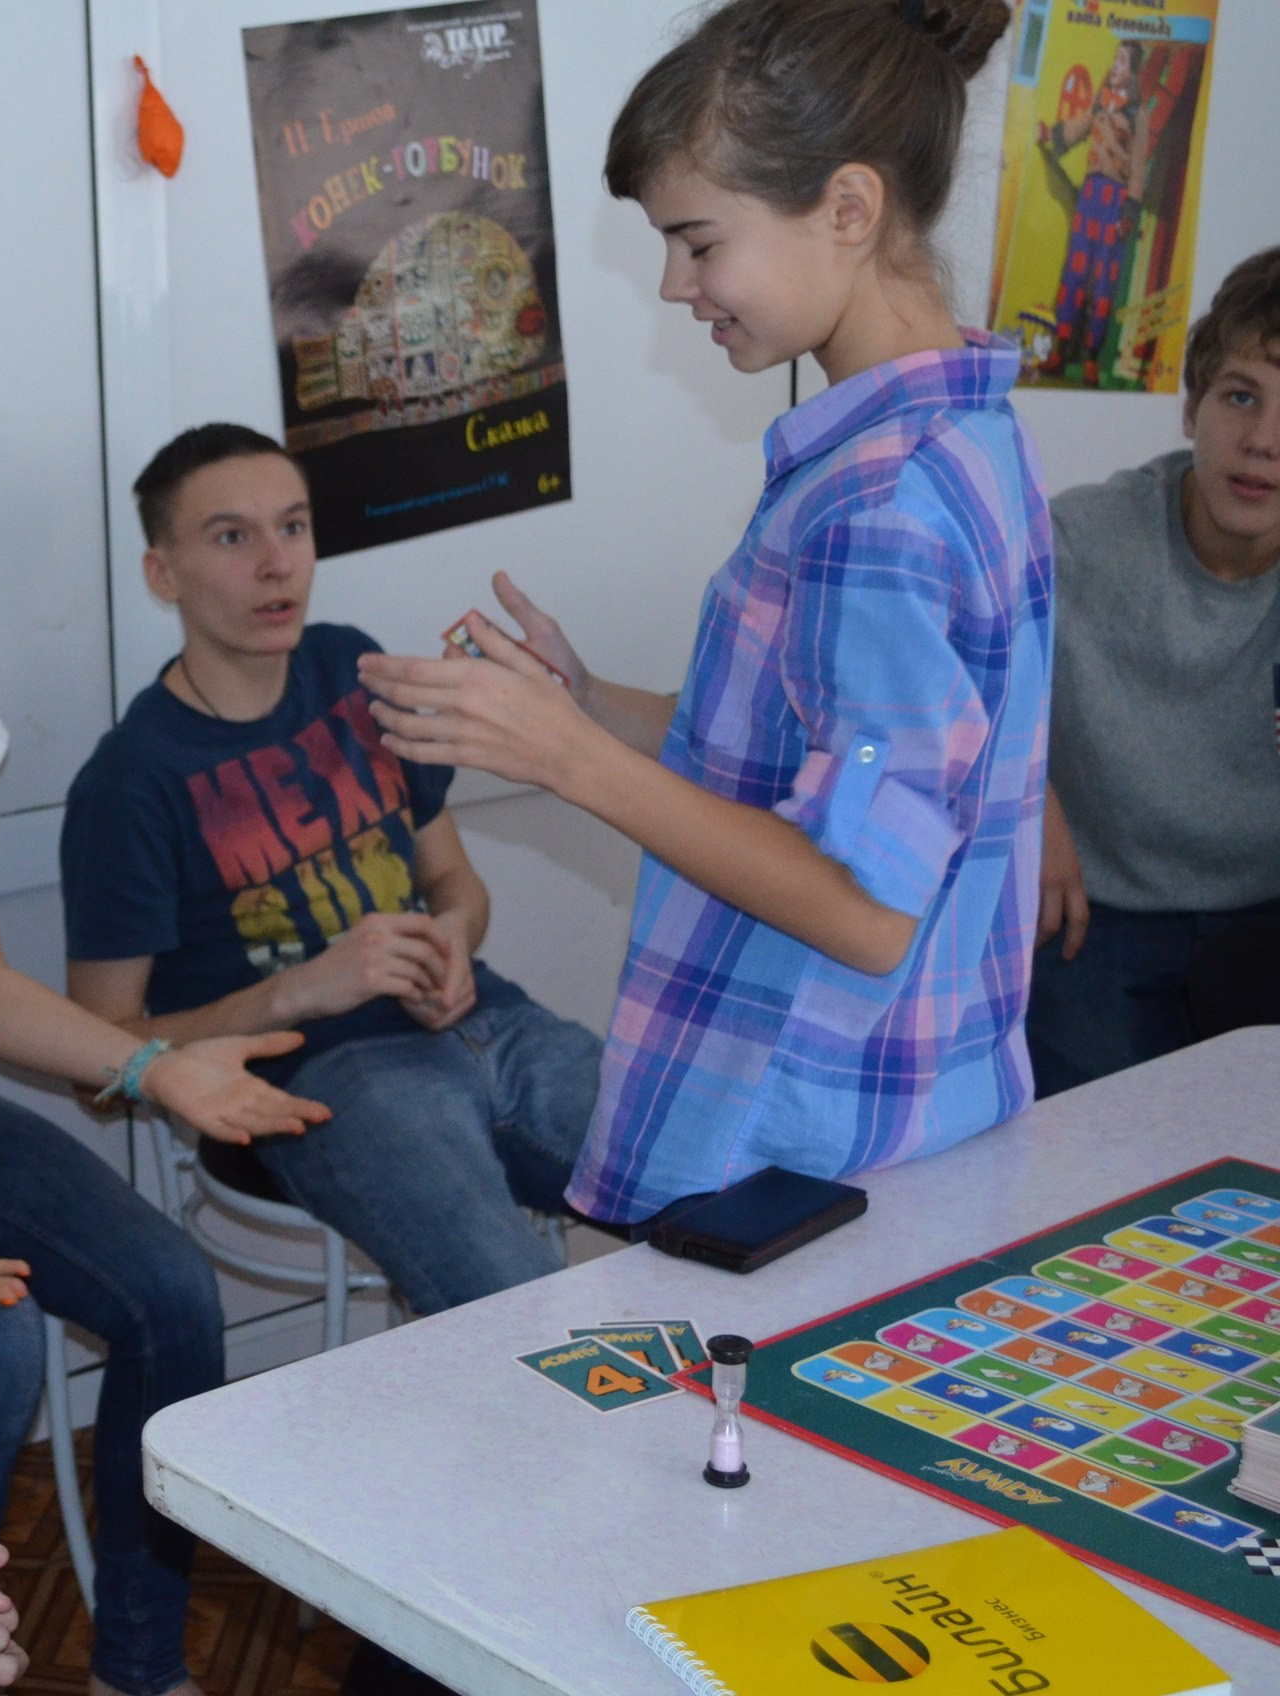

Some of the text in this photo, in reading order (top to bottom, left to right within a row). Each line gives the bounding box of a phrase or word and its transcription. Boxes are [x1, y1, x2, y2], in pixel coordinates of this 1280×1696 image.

[466, 410, 551, 452] Сказка
[538, 472, 561, 495] 6+
[585, 1363, 648, 1397] 4
[934, 1457, 1063, 1505] ACTIVITY
[881, 1573, 1051, 1696] Билайн
